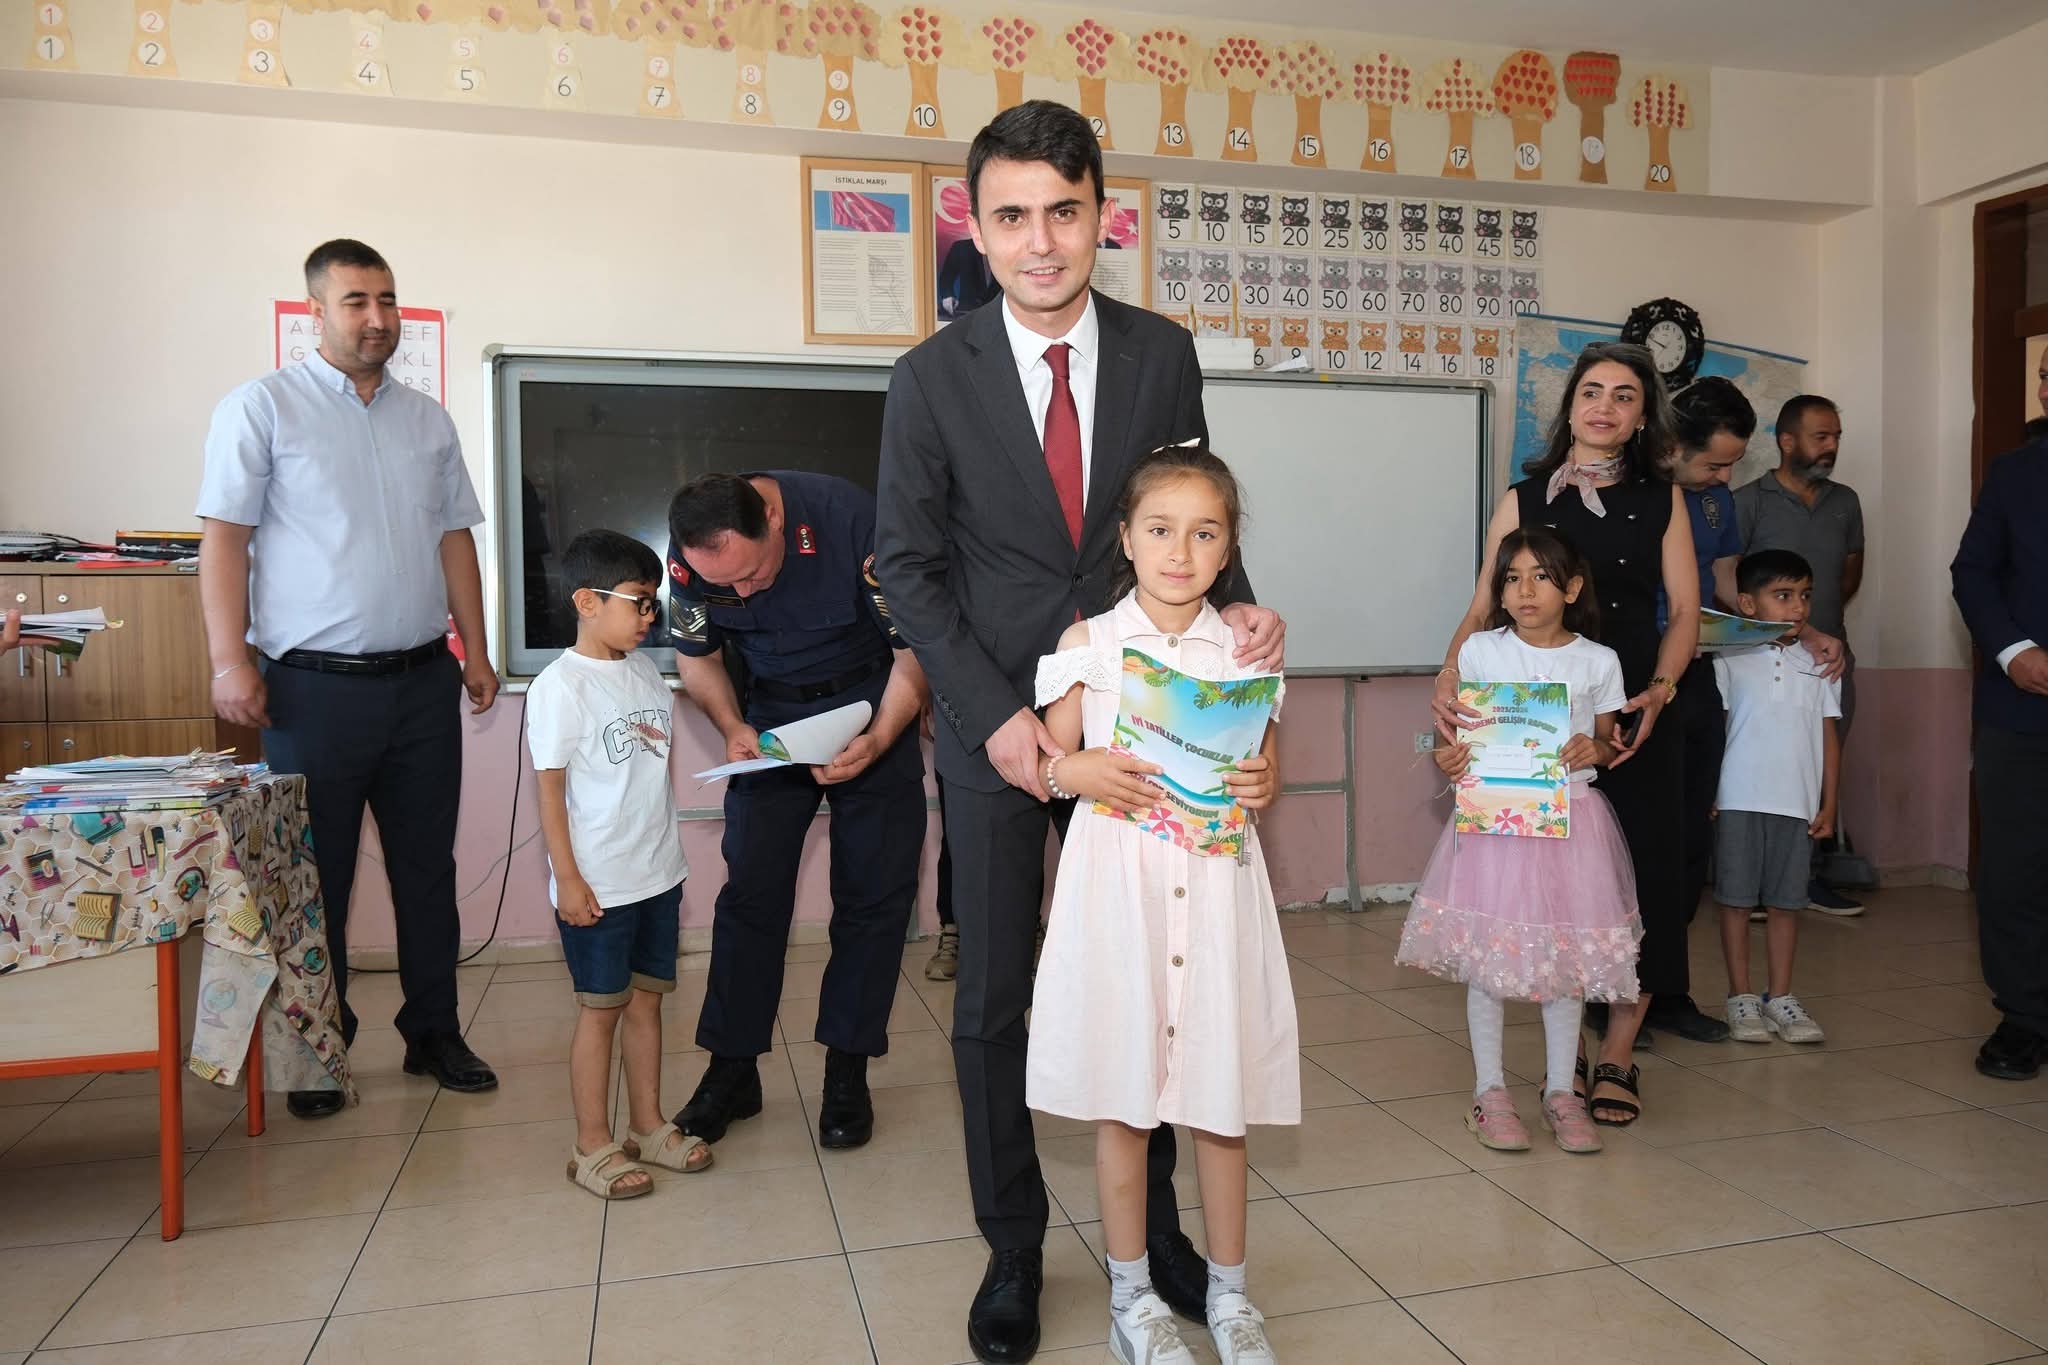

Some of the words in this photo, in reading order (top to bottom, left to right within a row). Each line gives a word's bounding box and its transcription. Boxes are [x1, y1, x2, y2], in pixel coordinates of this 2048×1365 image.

[45, 8, 53, 25] 1
[146, 12, 158, 30] 2
[257, 23, 269, 39] 3
[44, 37, 53, 60] 1
[359, 33, 372, 49] 4
[459, 40, 471, 57] 5
[144, 42, 159, 66] 2
[254, 51, 270, 73] 3
[558, 47, 569, 63] 6
[359, 62, 376, 83] 4
[654, 59, 665, 75] 7
[745, 66, 756, 83] 8
[460, 69, 474, 91] 5
[558, 76, 572, 97] 6
[834, 72, 844, 89] 9
[653, 86, 665, 106] 7
[745, 94, 757, 114] 8
[834, 100, 845, 120] 9
[914, 107, 937, 127] 10
[1088, 118, 1104, 138] 2
[1163, 125, 1184, 145] 13
[1229, 129, 1250, 149] 14
[1300, 137, 1318, 156] 15
[1370, 141, 1389, 160] 16
[1451, 148, 1467, 167] 17
[1519, 145, 1535, 166] 18
[866, 178, 887, 186] MARŞI
[1651, 165, 1671, 183] 20
[1168, 220, 1181, 239] 5
[1205, 222, 1225, 241] 10
[1247, 225, 1265, 244] 15
[1282, 227, 1309, 247] 20
[1324, 229, 1349, 248] 25
[1363, 231, 1387, 251] 30
[1403, 232, 1426, 251] 35
[1439, 235, 1463, 254] 40
[1477, 238, 1501, 257] 45
[1514, 240, 1537, 258] 50
[1166, 281, 1186, 301] 10
[1203, 283, 1230, 303] 20
[1244, 285, 1269, 305] 30
[1283, 287, 1309, 307] 40
[1322, 290, 1348, 309] 50
[1362, 292, 1387, 312] 60
[1401, 293, 1425, 312] 70
[1440, 294, 1462, 314] 80
[1477, 297, 1500, 316] 90
[1508, 299, 1540, 316] 100
[290, 320, 303, 336] A
[403, 325, 413, 340] E
[422, 326, 432, 341] F
[290, 346, 305, 361] G
[403, 352, 414, 367] K
[423, 352, 433, 367] L
[1254, 347, 1264, 366] 6
[1327, 350, 1346, 369] 10
[1364, 351, 1382, 370] 12
[1403, 353, 1422, 372] 14
[1441, 355, 1457, 373] 16
[1479, 357, 1495, 376] 18
[421, 377, 432, 392] S
[1144, 719, 1184, 748] TATİLLER
[1184, 742, 1234, 764] ÇOCUKLAR
